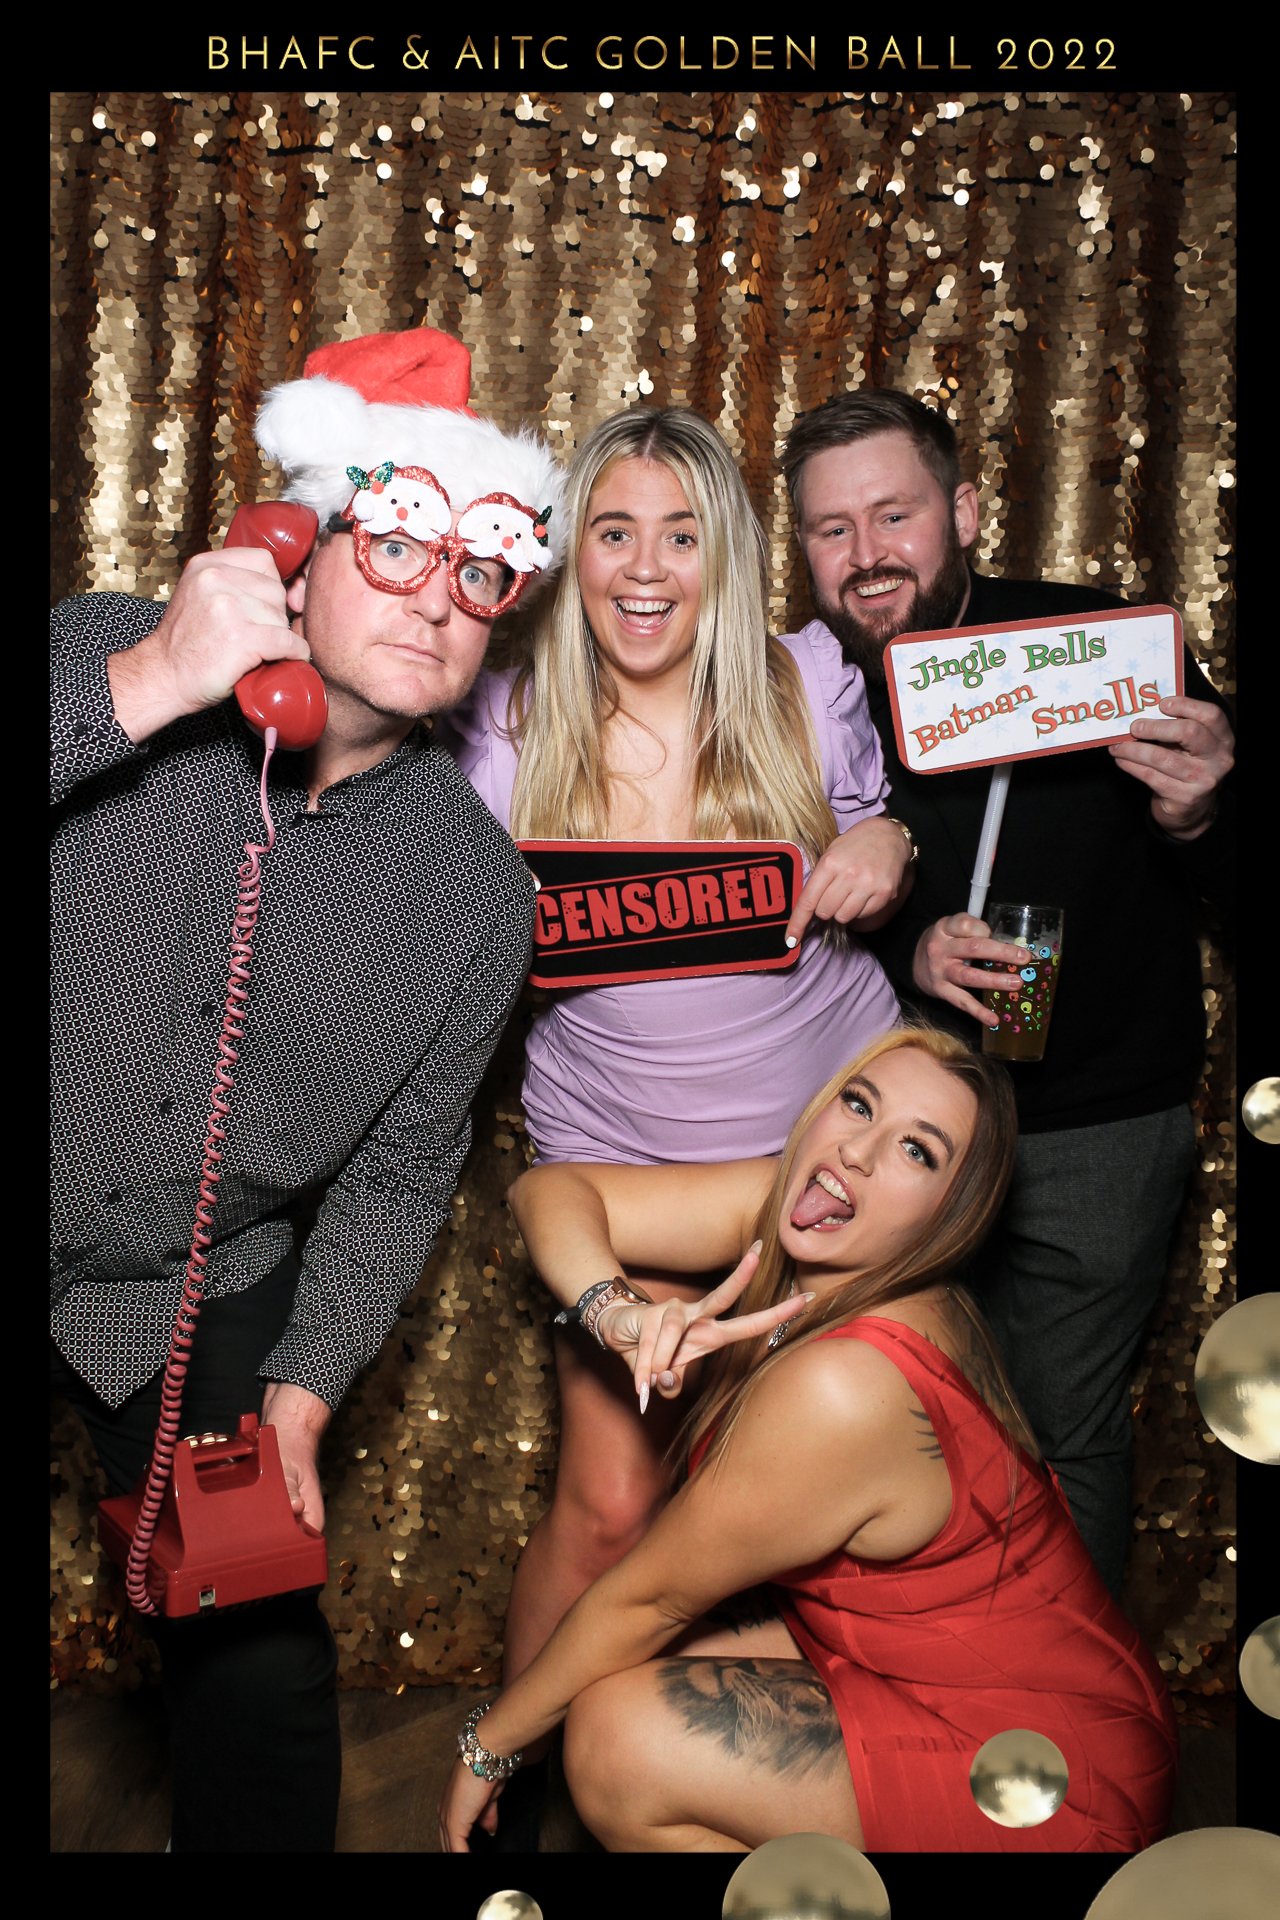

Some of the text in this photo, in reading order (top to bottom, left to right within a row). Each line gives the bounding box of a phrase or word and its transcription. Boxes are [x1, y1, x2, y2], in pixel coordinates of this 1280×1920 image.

[907, 630, 1107, 691] Jingle Bells
[908, 676, 1162, 757] Batman Smells
[534, 865, 786, 946] CENSORED
